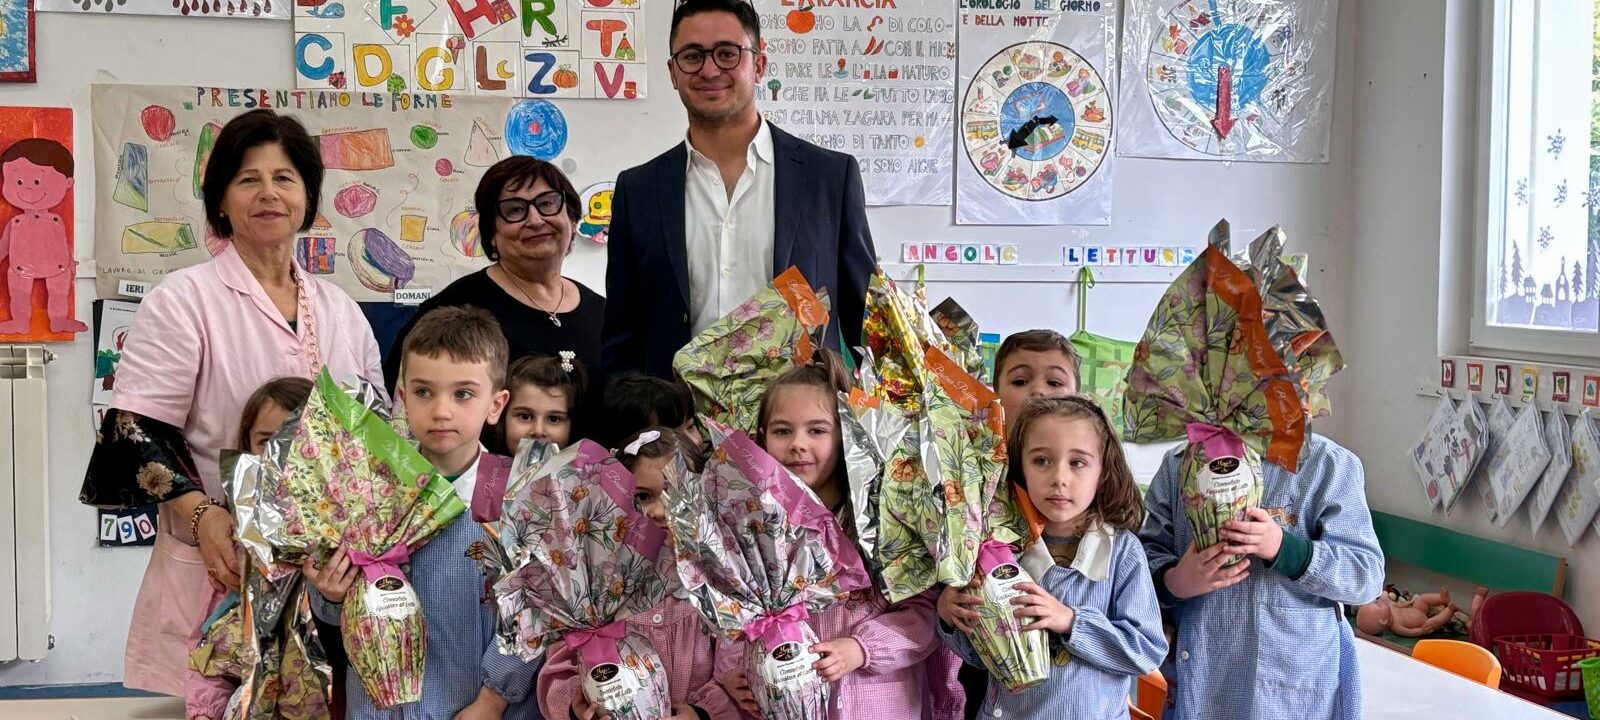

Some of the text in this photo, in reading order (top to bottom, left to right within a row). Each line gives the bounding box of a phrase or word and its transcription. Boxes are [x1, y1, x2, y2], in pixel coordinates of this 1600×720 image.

[1034, 0, 1053, 11] DEL
[1060, 0, 1101, 12] GIORNO
[447, 0, 498, 38] H
[522, 0, 557, 37] R
[759, 13, 953, 34] ONO HO LA DI COLO-
[963, 14, 1049, 28] E DELLA NOTTE
[586, 20, 626, 57] T
[767, 37, 807, 55] SONO
[812, 38, 848, 56] FATTA
[884, 39, 912, 58] CON
[915, 40, 926, 58] IL
[295, 33, 625, 99] C D G L Z V
[785, 62, 813, 79] FARE
[817, 63, 833, 80] LE
[902, 64, 950, 82] MATURO
[196, 86, 452, 112] PRESENTIAMO LE FORME
[782, 86, 810, 102] CHE
[814, 86, 830, 103] HA
[834, 86, 850, 103] LE
[874, 88, 920, 104] TUTTO
[773, 110, 788, 126] SI
[790, 111, 840, 127] CHIAMA
[844, 111, 897, 127] ZAGARA
[901, 112, 920, 128] PER
[852, 135, 865, 150] DI
[869, 135, 910, 151] TANTO
[873, 160, 903, 174] SONO
[907, 160, 938, 174] ANCHE
[126, 284, 144, 293] IERI
[396, 292, 431, 300] DOMANI
[931, 361, 958, 385] Buona
[104, 518, 115, 537] 7
[120, 520, 133, 539] 9
